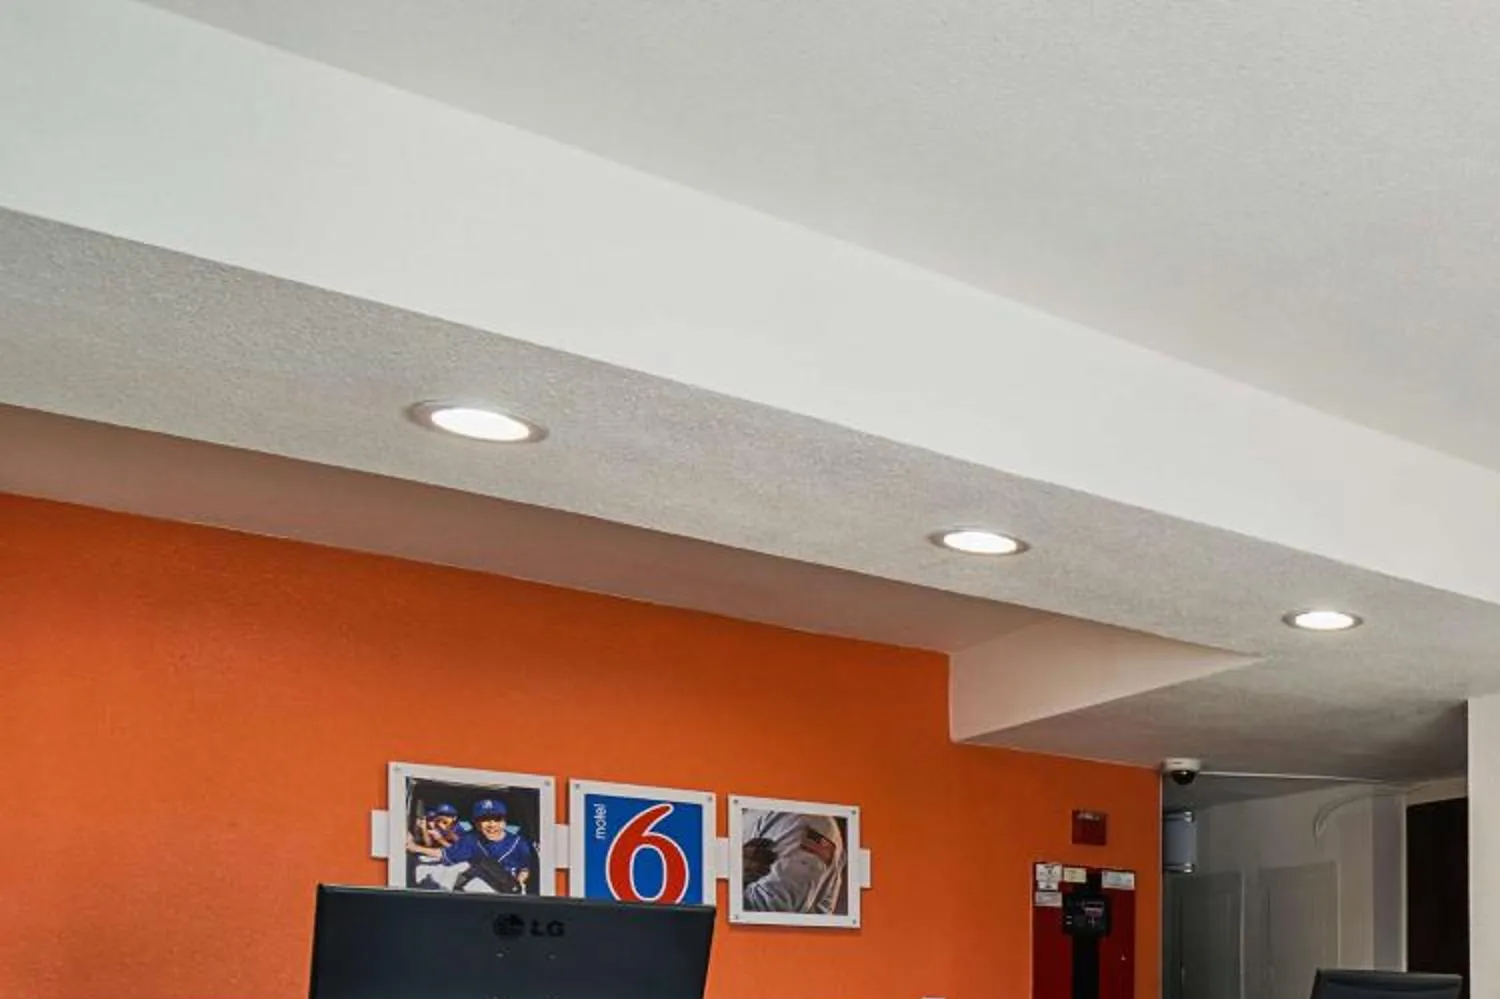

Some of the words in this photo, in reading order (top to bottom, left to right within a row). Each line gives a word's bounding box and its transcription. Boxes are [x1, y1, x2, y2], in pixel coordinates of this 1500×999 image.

[594, 803, 606, 840] motel
[606, 803, 689, 904] 6
[530, 920, 565, 937] LG
